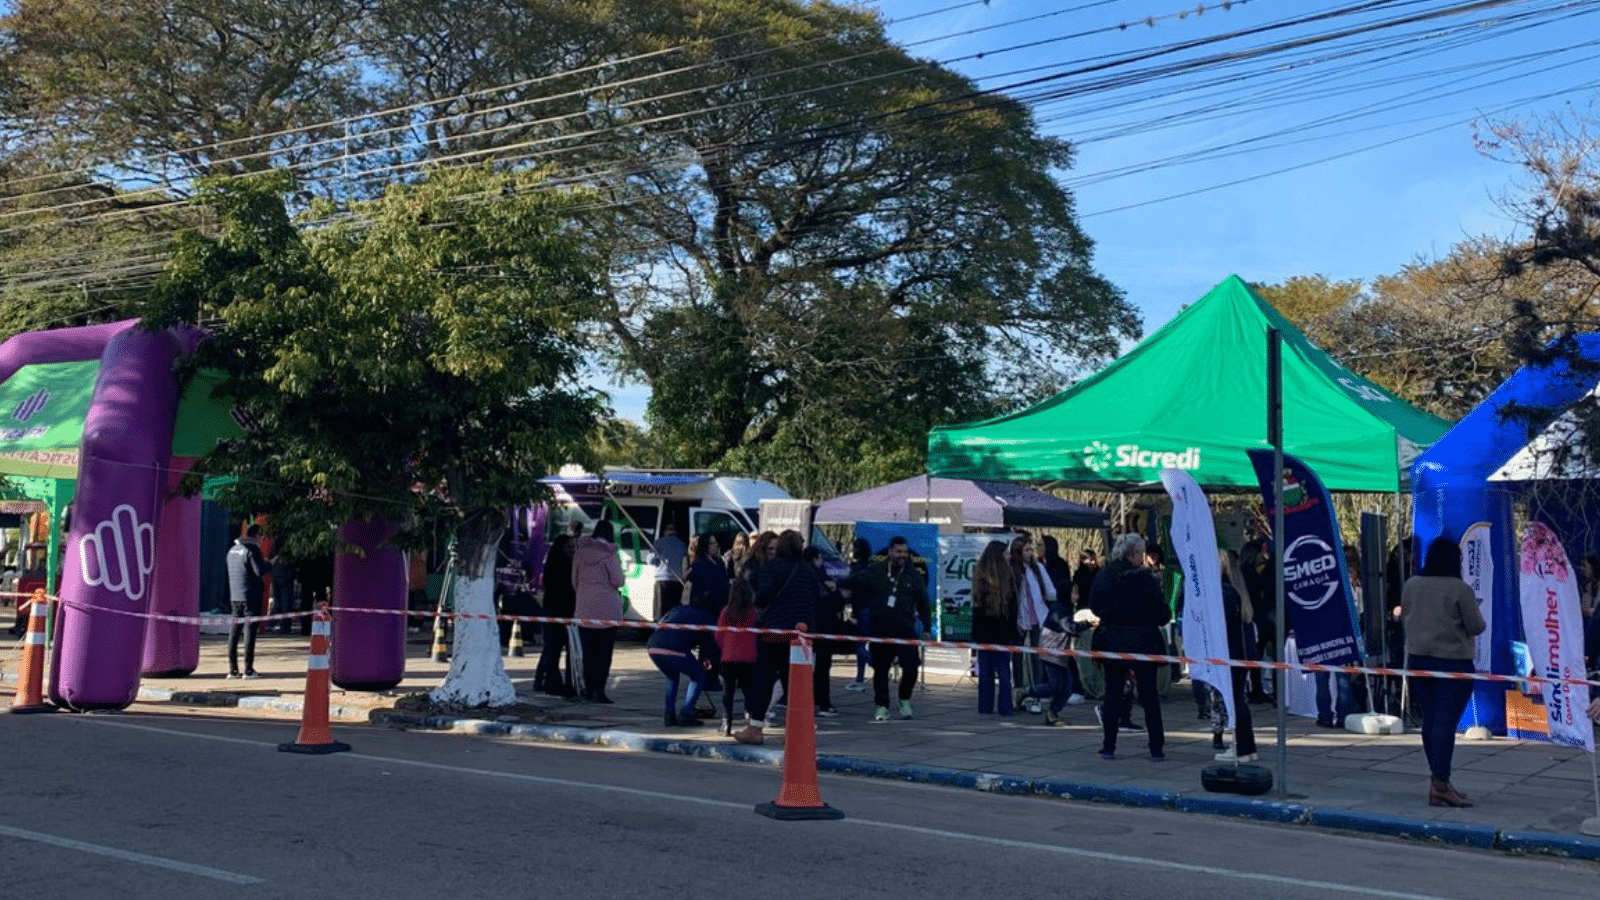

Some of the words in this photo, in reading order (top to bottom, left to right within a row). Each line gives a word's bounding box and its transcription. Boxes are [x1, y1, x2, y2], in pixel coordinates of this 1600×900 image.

[1115, 444, 1201, 470] Sicredi
[586, 484, 630, 494] ESTDIO
[1283, 554, 1336, 581] SMED
